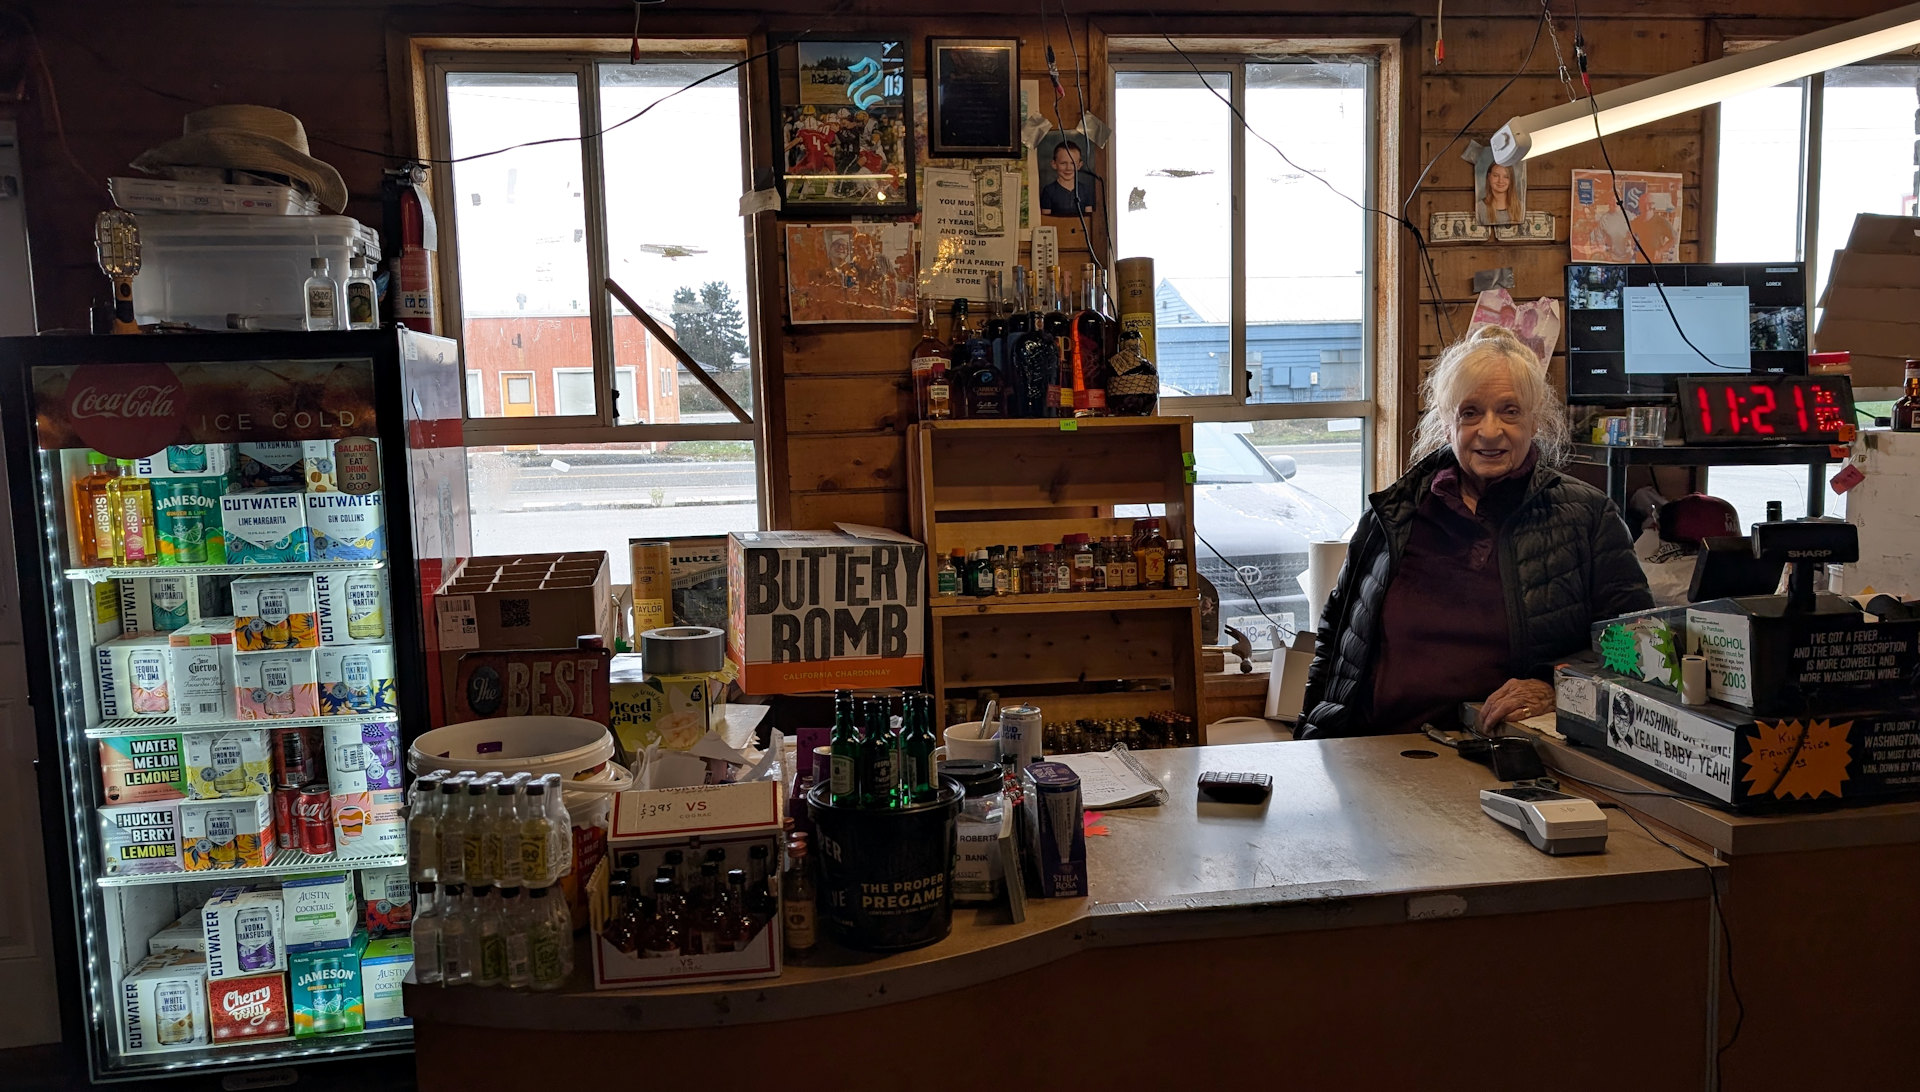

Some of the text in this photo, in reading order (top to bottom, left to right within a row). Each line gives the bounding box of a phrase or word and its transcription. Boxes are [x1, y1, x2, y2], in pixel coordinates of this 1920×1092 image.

[939, 198, 975, 207] YOU MUS
[948, 218, 974, 226] YEARS
[71, 384, 177, 419] Coca-Cola
[1697, 384, 1809, 434] 11:21
[202, 410, 355, 431] ICE COLD
[338, 444, 374, 453] BALANCE
[345, 465, 370, 473] DRINK
[156, 495, 215, 511] JAMESON
[223, 496, 298, 511] CUTWATER
[309, 494, 382, 509] CUTWATER
[238, 516, 287, 526] LIME MARGARITA
[328, 513, 365, 523] GIN COLLINS
[1787, 549, 1833, 558] SHARP
[160, 583, 176, 591] LIME
[746, 545, 924, 616] BUTTERY
[153, 591, 184, 600] MARGARITA
[347, 591, 364, 600] LEMON
[352, 598, 376, 606] MARTINI
[122, 578, 138, 633] CUTWATE
[316, 575, 334, 642] CUTWATER
[635, 605, 663, 613] TAYLOR
[1702, 635, 1746, 651] ALCOHOL
[1810, 632, 1827, 645] I'VE
[1828, 631, 1843, 643] GOT
[1845, 631, 1852, 642] A
[1793, 641, 1908, 659] AND THE ONLY PRESCRIPTION
[135, 665, 159, 673] TEQUILA
[188, 662, 217, 674] Cuervo
[1806, 654, 1896, 671] IS MORE COWBELL AND
[137, 672, 160, 681] PALOMA
[783, 668, 891, 681] CALIFORNIA CHARDONNAY
[1722, 671, 1747, 690] 2003
[1799, 671, 1821, 683] MORE
[1823, 669, 1876, 683] WASHINGTON
[99, 649, 117, 716] CUTWATER
[268, 679, 287, 687] PALOMA
[507, 658, 599, 717] BEST
[473, 677, 497, 704] The
[611, 712, 652, 726] ears
[1874, 720, 1916, 733] IF YOU DON'T
[132, 739, 177, 754] WATER
[212, 752, 227, 760] LEMON
[1633, 726, 1731, 786] YEAH, BABY, YEAH!
[1873, 749, 1906, 760] YOU MUST
[134, 754, 179, 769] MELON
[125, 769, 181, 786] LEMON ADE
[686, 801, 707, 812] VS
[123, 811, 172, 827] HUCKLE
[132, 828, 174, 842] BERRY
[959, 833, 998, 842] ROBERTS
[121, 843, 176, 860] LEMON ADE
[861, 873, 944, 895] THE PROPER
[1052, 874, 1079, 882] STELLA
[1055, 881, 1077, 890] ROSA
[297, 890, 331, 903] AUSTIN
[861, 885, 944, 909] PREGAME
[295, 903, 334, 913] COCKTAILS
[244, 923, 264, 932] VODKA
[237, 931, 273, 940] TRANSFUSION
[206, 910, 223, 977] CUTWATER
[680, 958, 694, 966] VS
[297, 969, 355, 987] JAMESON
[374, 981, 402, 991] COCKTA
[163, 997, 183, 1005] WHITE
[222, 985, 271, 1011] Cherry
[161, 1004, 187, 1013] RUSSIAN
[126, 983, 143, 1049] CUTWATER
